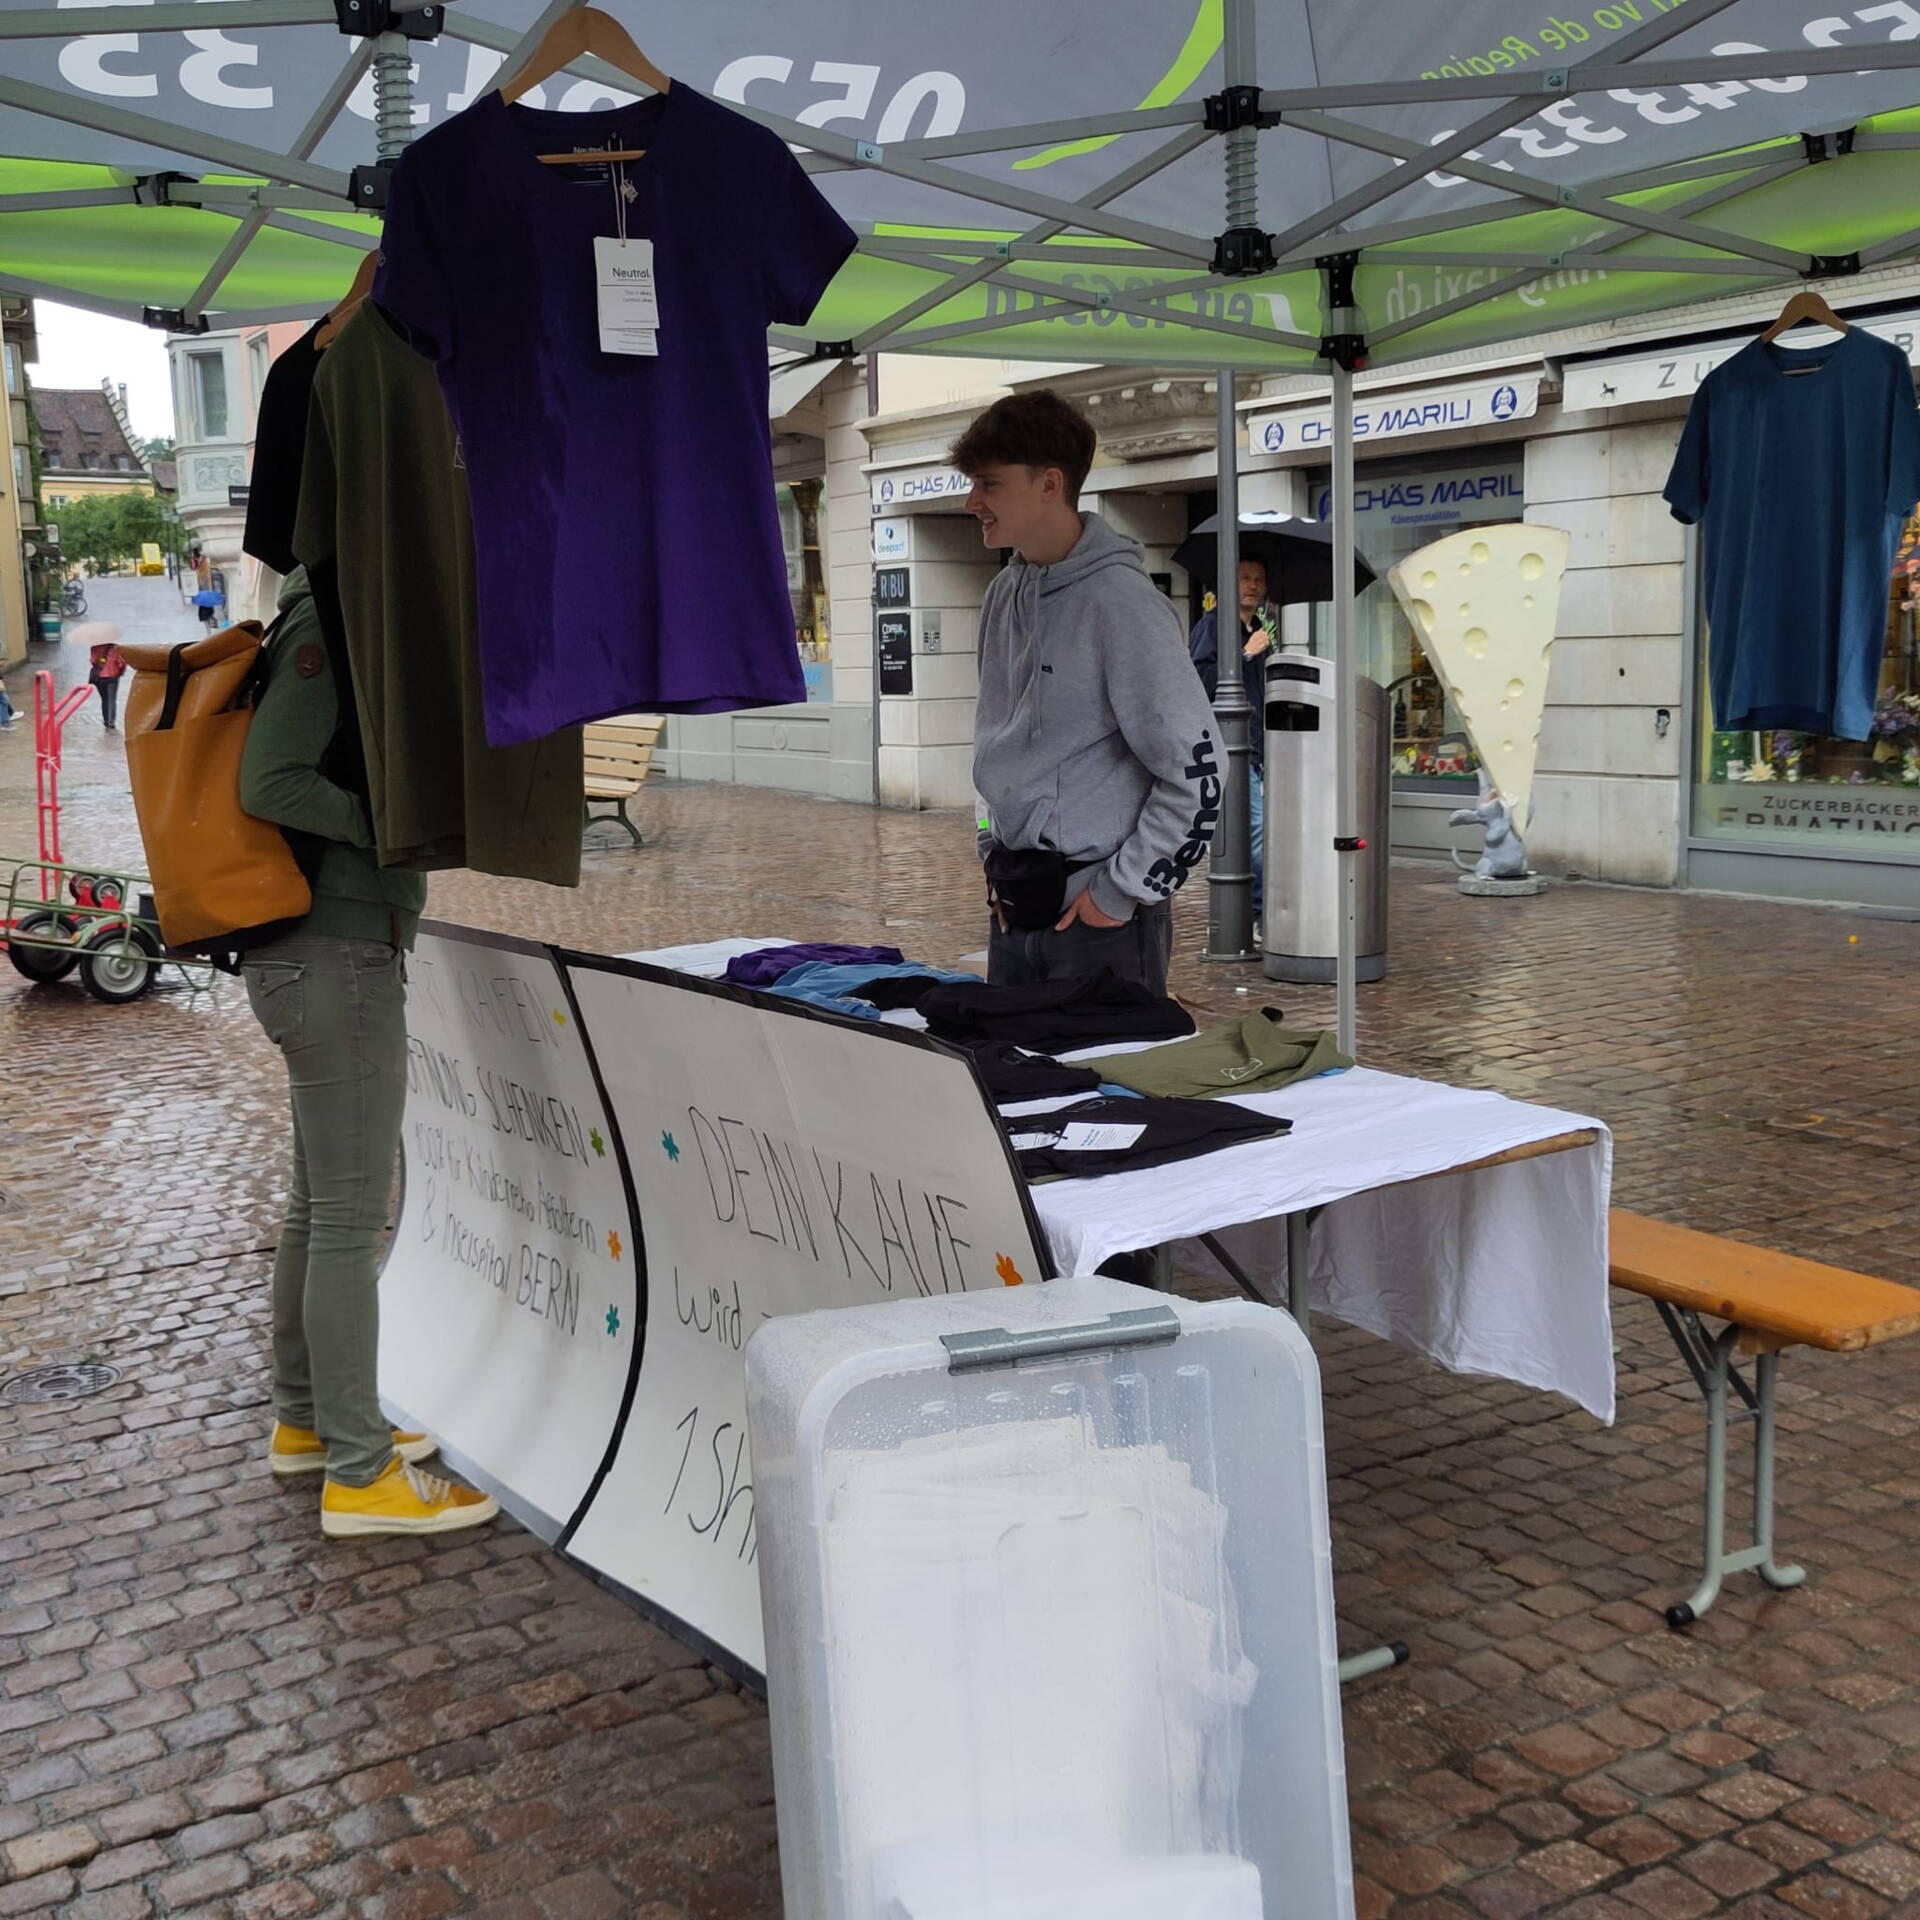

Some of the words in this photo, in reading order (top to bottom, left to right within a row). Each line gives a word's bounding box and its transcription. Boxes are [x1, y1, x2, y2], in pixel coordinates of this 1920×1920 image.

[1301, 414, 1369, 442] CHS
[1376, 399, 1471, 433] MARILI
[903, 475, 943, 497] CHÄS
[1354, 483, 1424, 512] CHÄS
[477, 1066, 589, 1168] SCHENKEN
[689, 1107, 819, 1262] DEIN
[811, 1146, 971, 1297] KAUF
[516, 1243, 581, 1337] BERN
[664, 1406, 699, 1515] 1
[688, 1422, 758, 1565] Sh
